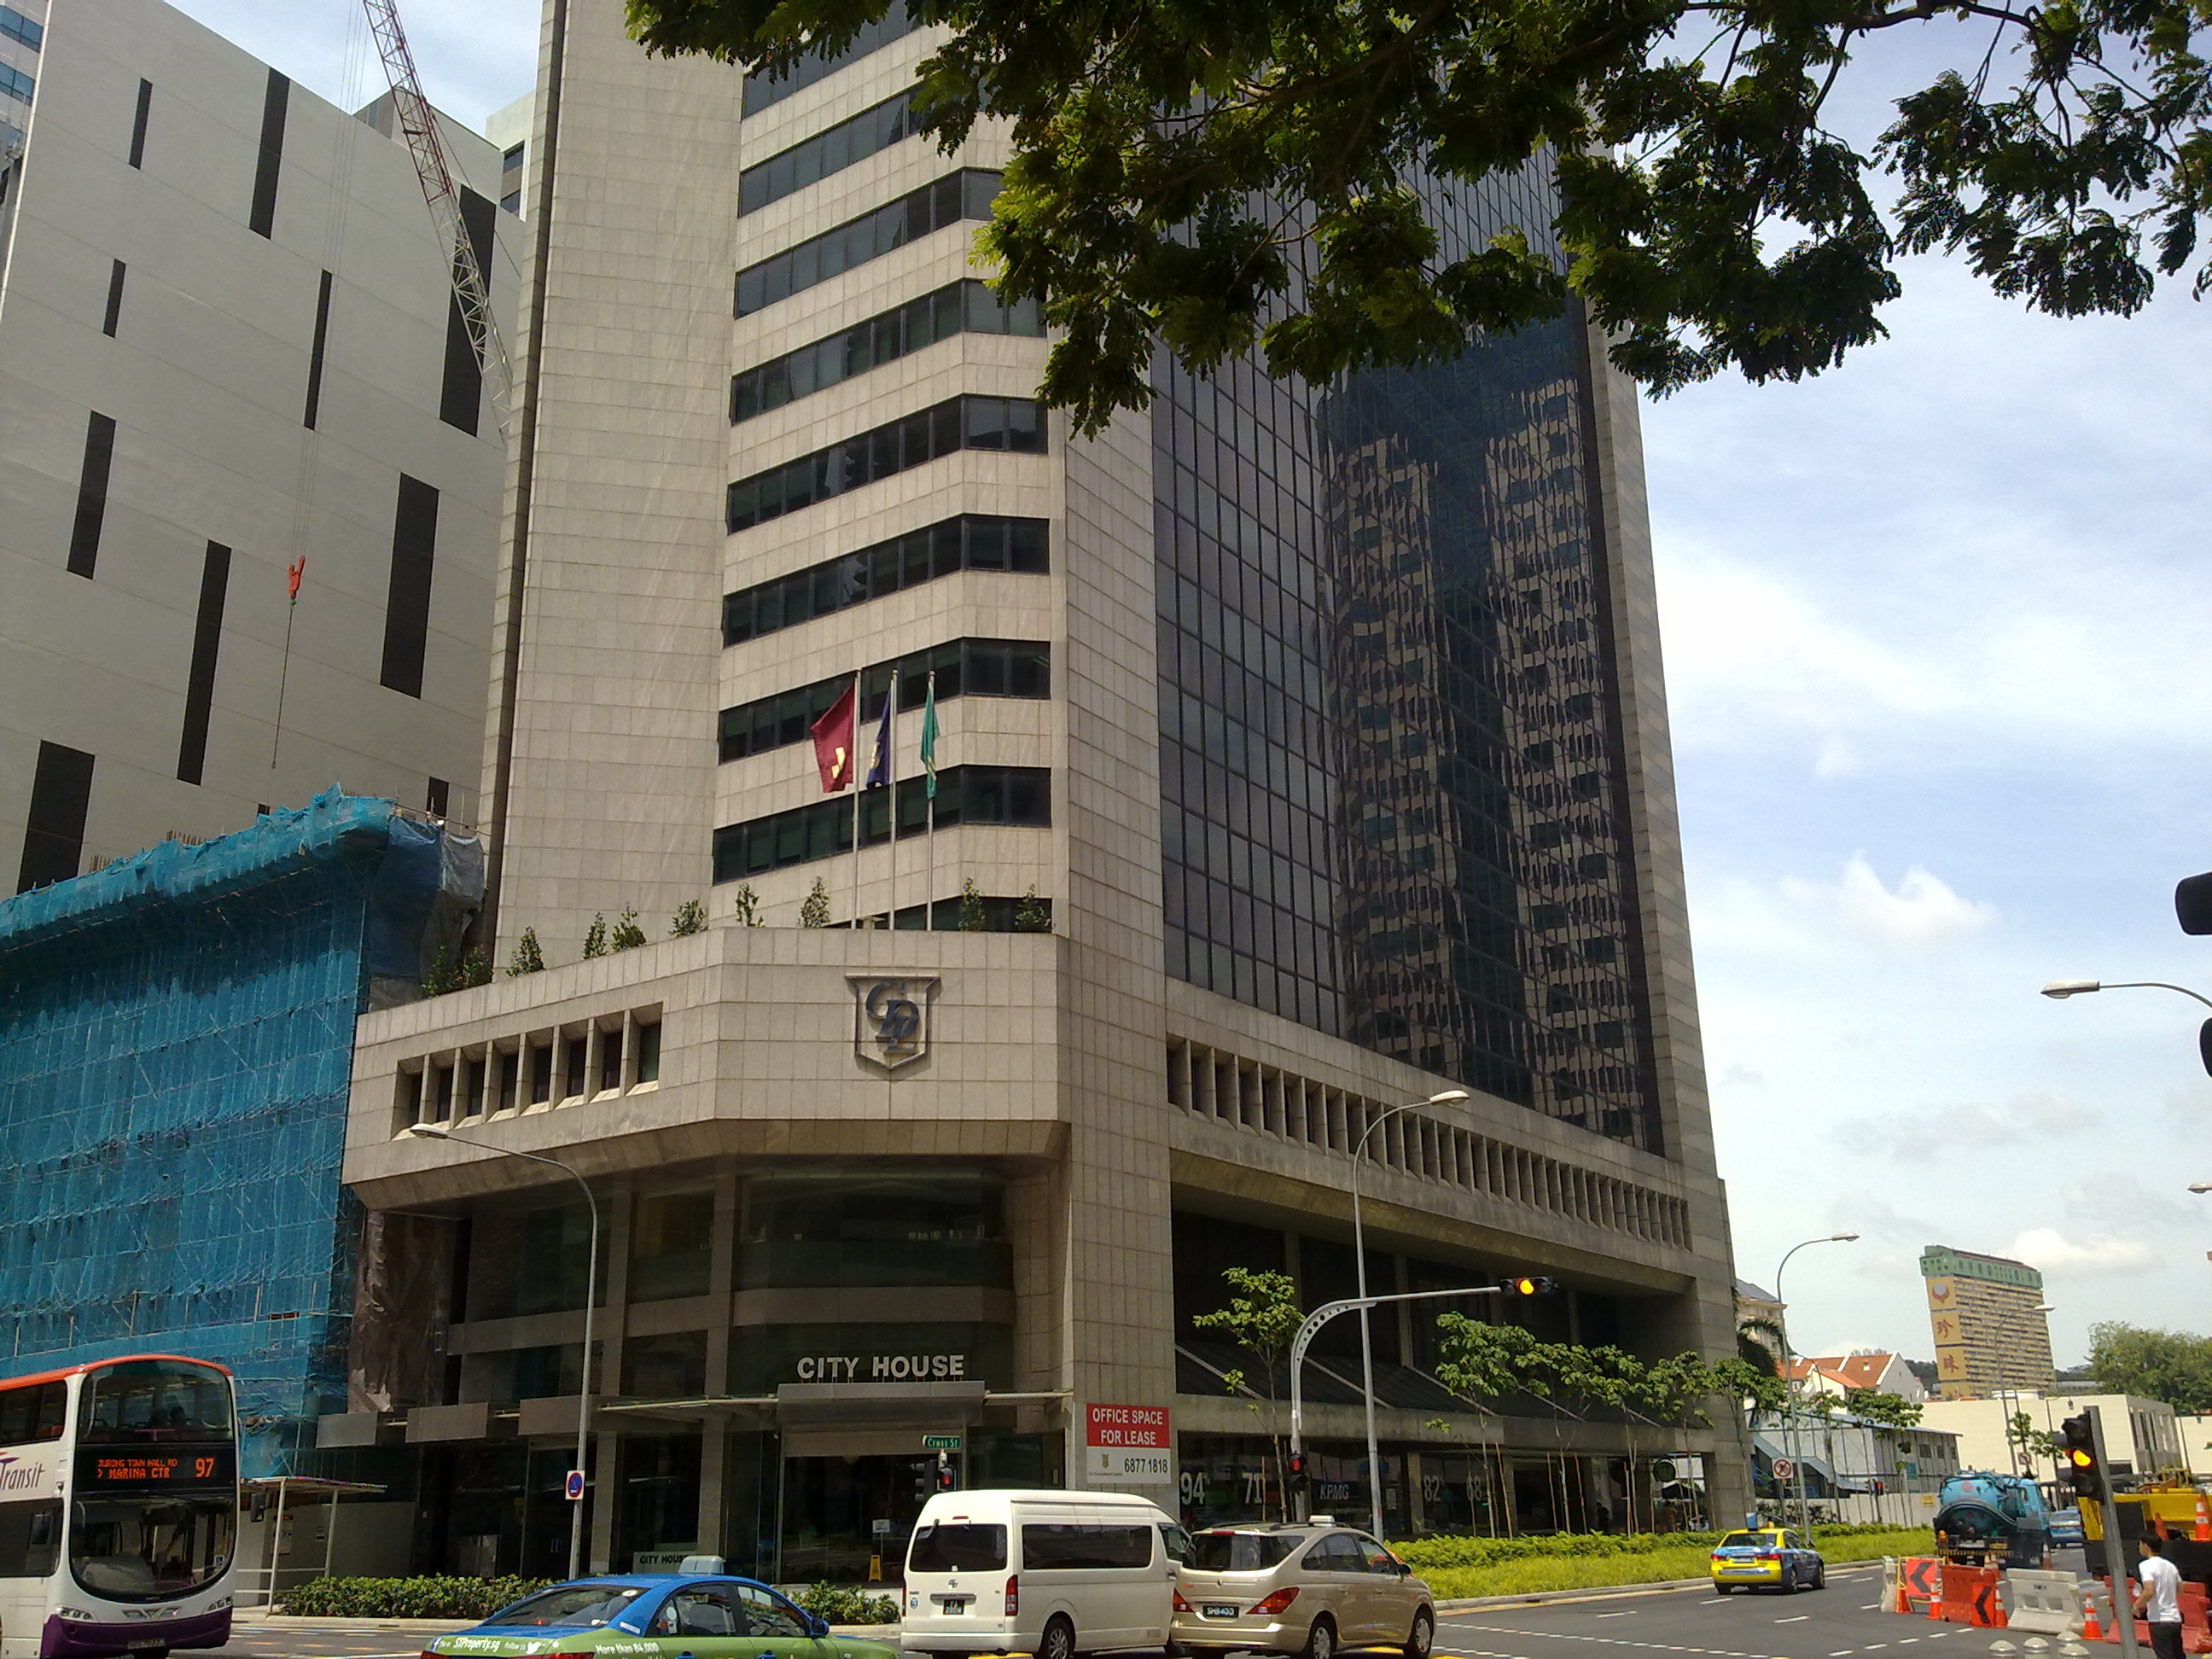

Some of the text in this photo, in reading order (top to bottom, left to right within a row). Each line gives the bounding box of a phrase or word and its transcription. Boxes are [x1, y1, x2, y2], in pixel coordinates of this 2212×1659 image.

[797, 1355, 964, 1379] CITY HOUSE
[1092, 1408, 1163, 1425] OFFICE SPACE
[1101, 1429, 1156, 1446] FOR LEASE
[148, 1458, 165, 1467] HALL
[195, 1458, 214, 1477] 97
[1124, 1458, 1167, 1474] 6877 1818
[0, 1458, 45, 1490] Transit
[108, 1467, 170, 1479] MARINA CTR
[1319, 1484, 1349, 1500] KPMG
[639, 1555, 658, 1564] CITY
[595, 1644, 615, 1655] More
[615, 1643, 633, 1654] than
